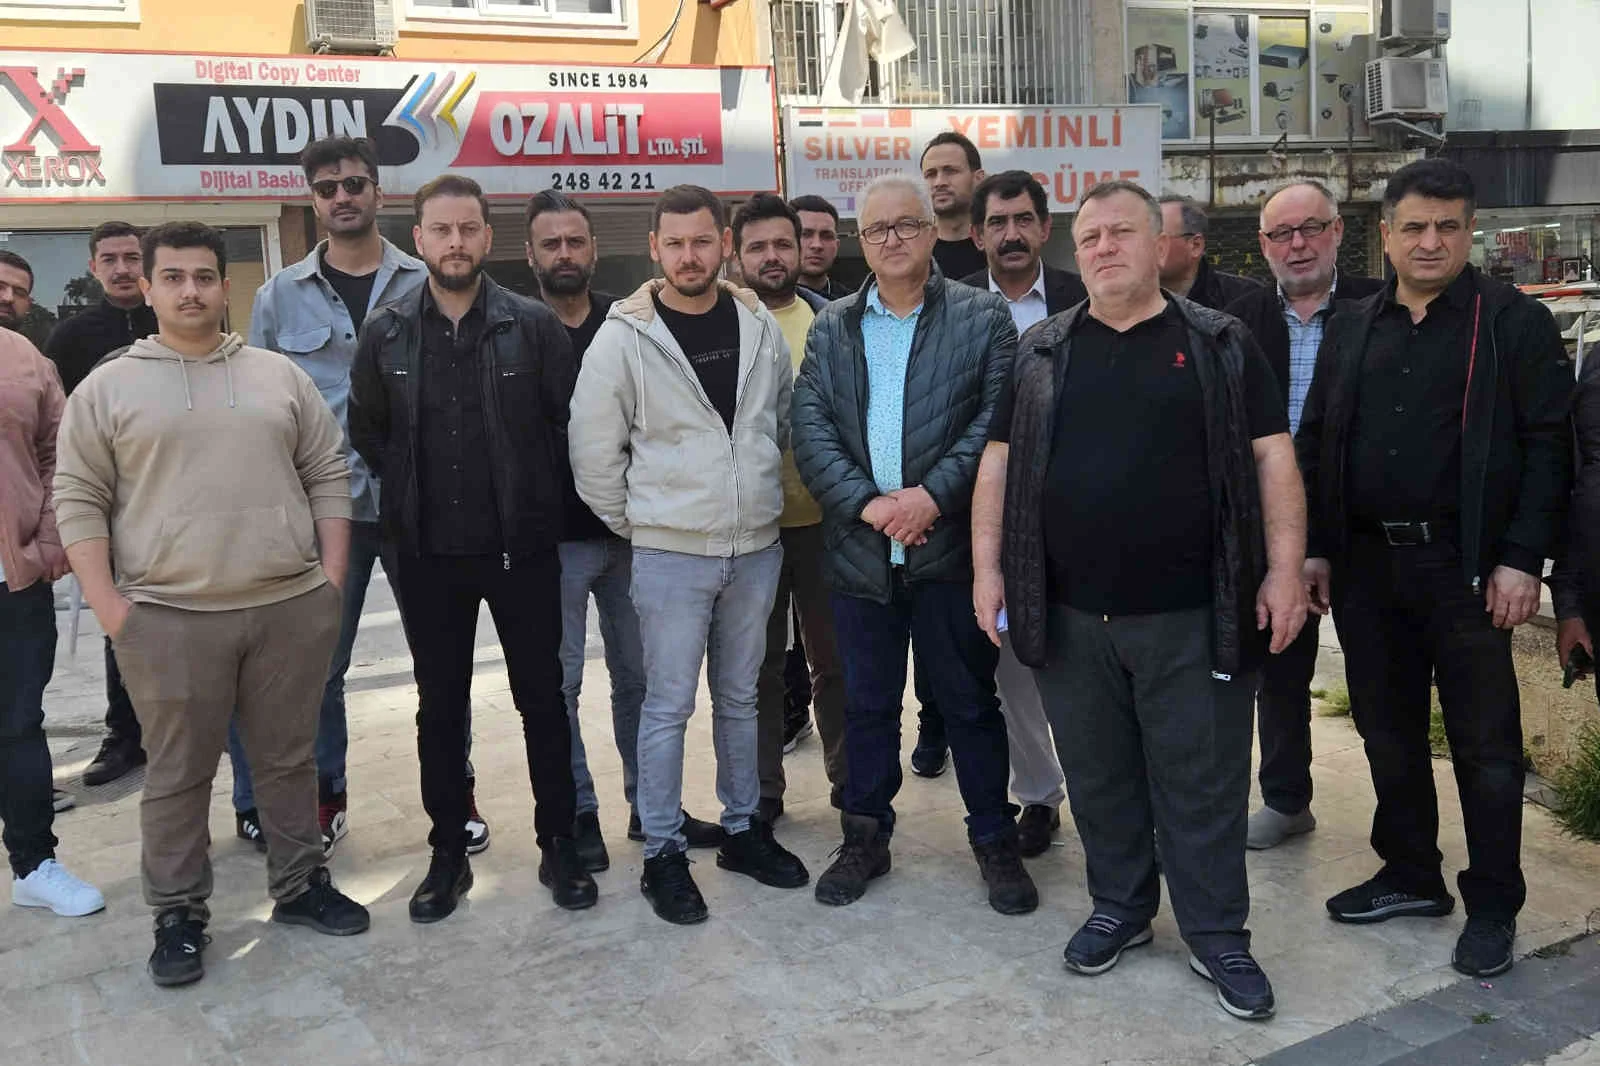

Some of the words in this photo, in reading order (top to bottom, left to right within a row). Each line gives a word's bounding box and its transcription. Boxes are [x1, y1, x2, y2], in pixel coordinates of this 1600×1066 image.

[194, 60, 252, 83] Digital
[258, 62, 299, 85] Copy
[305, 64, 361, 82] Center
[549, 72, 600, 87] SINCE
[607, 73, 648, 89] 1984
[203, 96, 367, 153] AYDIN
[648, 138, 678, 156] LTD.
[2, 155, 105, 185] XEROX
[200, 171, 252, 192] Dijital
[552, 172, 590, 190] 248
[598, 173, 622, 190] 42
[631, 173, 655, 190] 21
